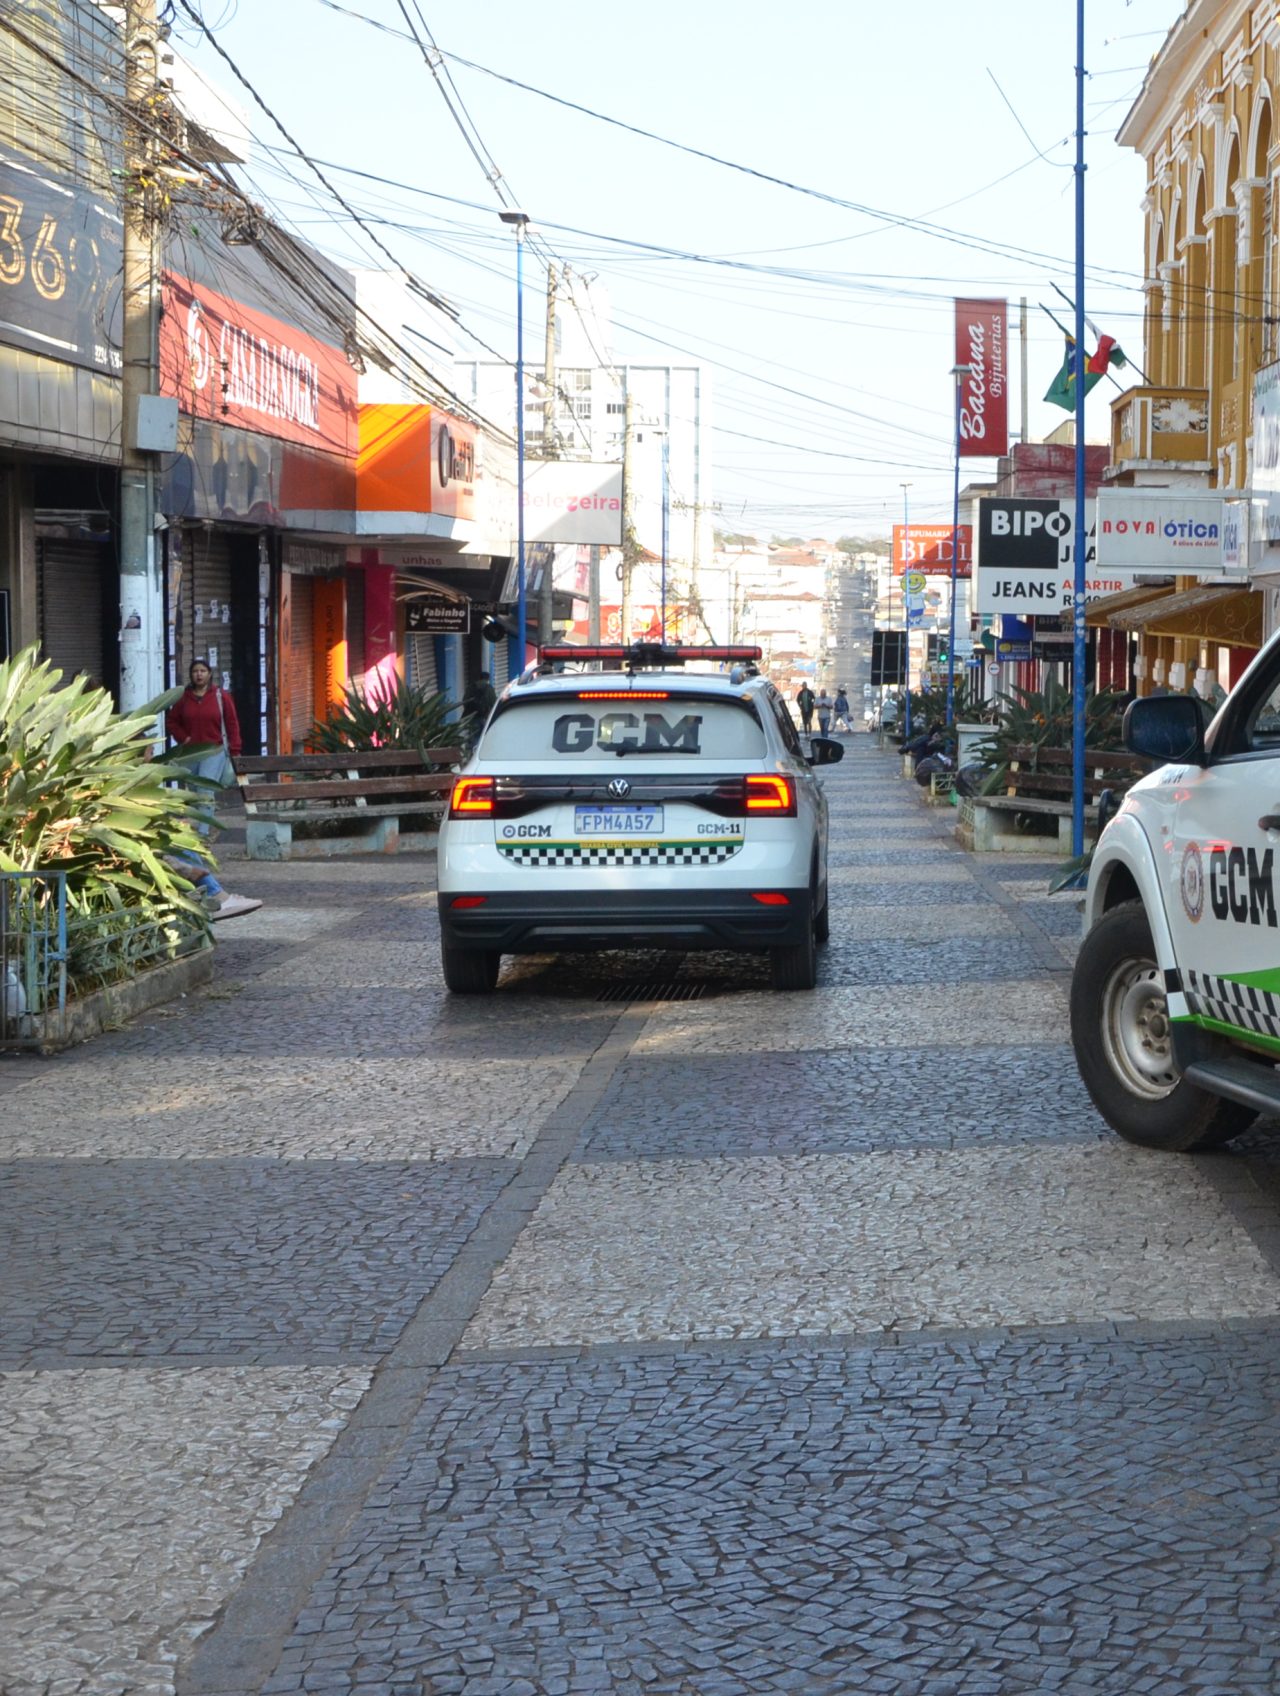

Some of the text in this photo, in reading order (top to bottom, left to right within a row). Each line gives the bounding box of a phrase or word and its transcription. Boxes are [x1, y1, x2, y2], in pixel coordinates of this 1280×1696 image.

[988, 314, 1006, 398] Bijuterias
[960, 321, 986, 440] Bacana
[991, 510, 1096, 538] BIPO
[402, 555, 443, 565] unhas
[992, 581, 1057, 599] JEANS
[1074, 580, 1122, 591] ARTIR
[423, 607, 466, 617] Fabinho
[552, 713, 703, 755] GCM
[517, 825, 552, 838] GCM
[582, 814, 654, 832] FPM4A57
[697, 823, 741, 834] GCM-11
[1210, 845, 1278, 928] GCM
